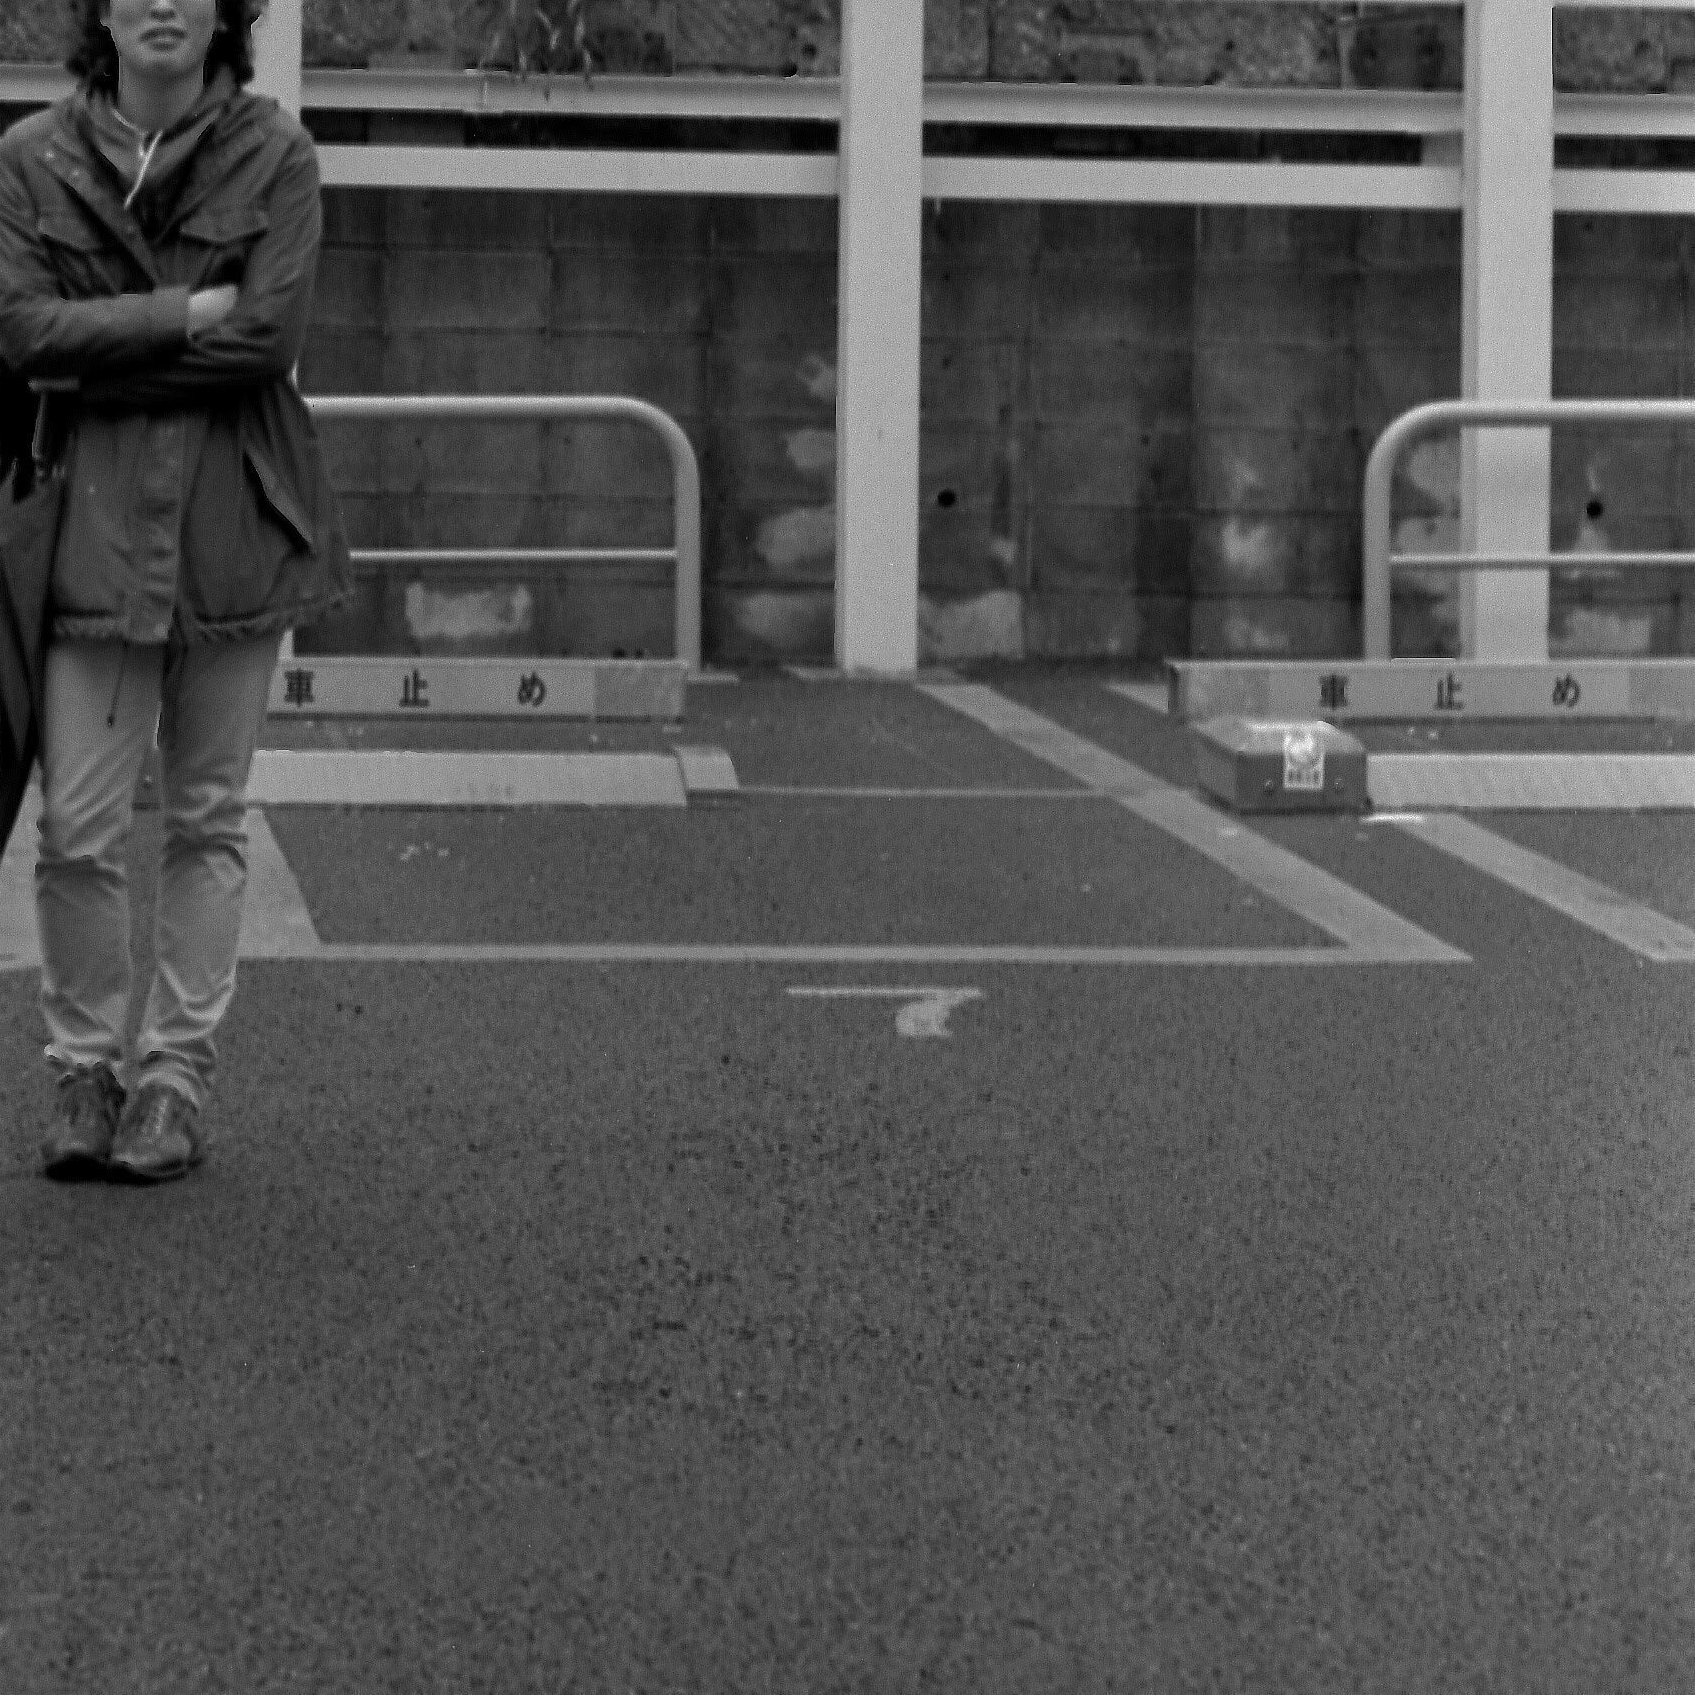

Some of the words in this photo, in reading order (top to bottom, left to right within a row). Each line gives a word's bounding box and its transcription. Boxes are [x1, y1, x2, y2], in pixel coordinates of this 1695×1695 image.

[284, 668, 546, 707] 車止め
[1319, 672, 1581, 710] 車止め
